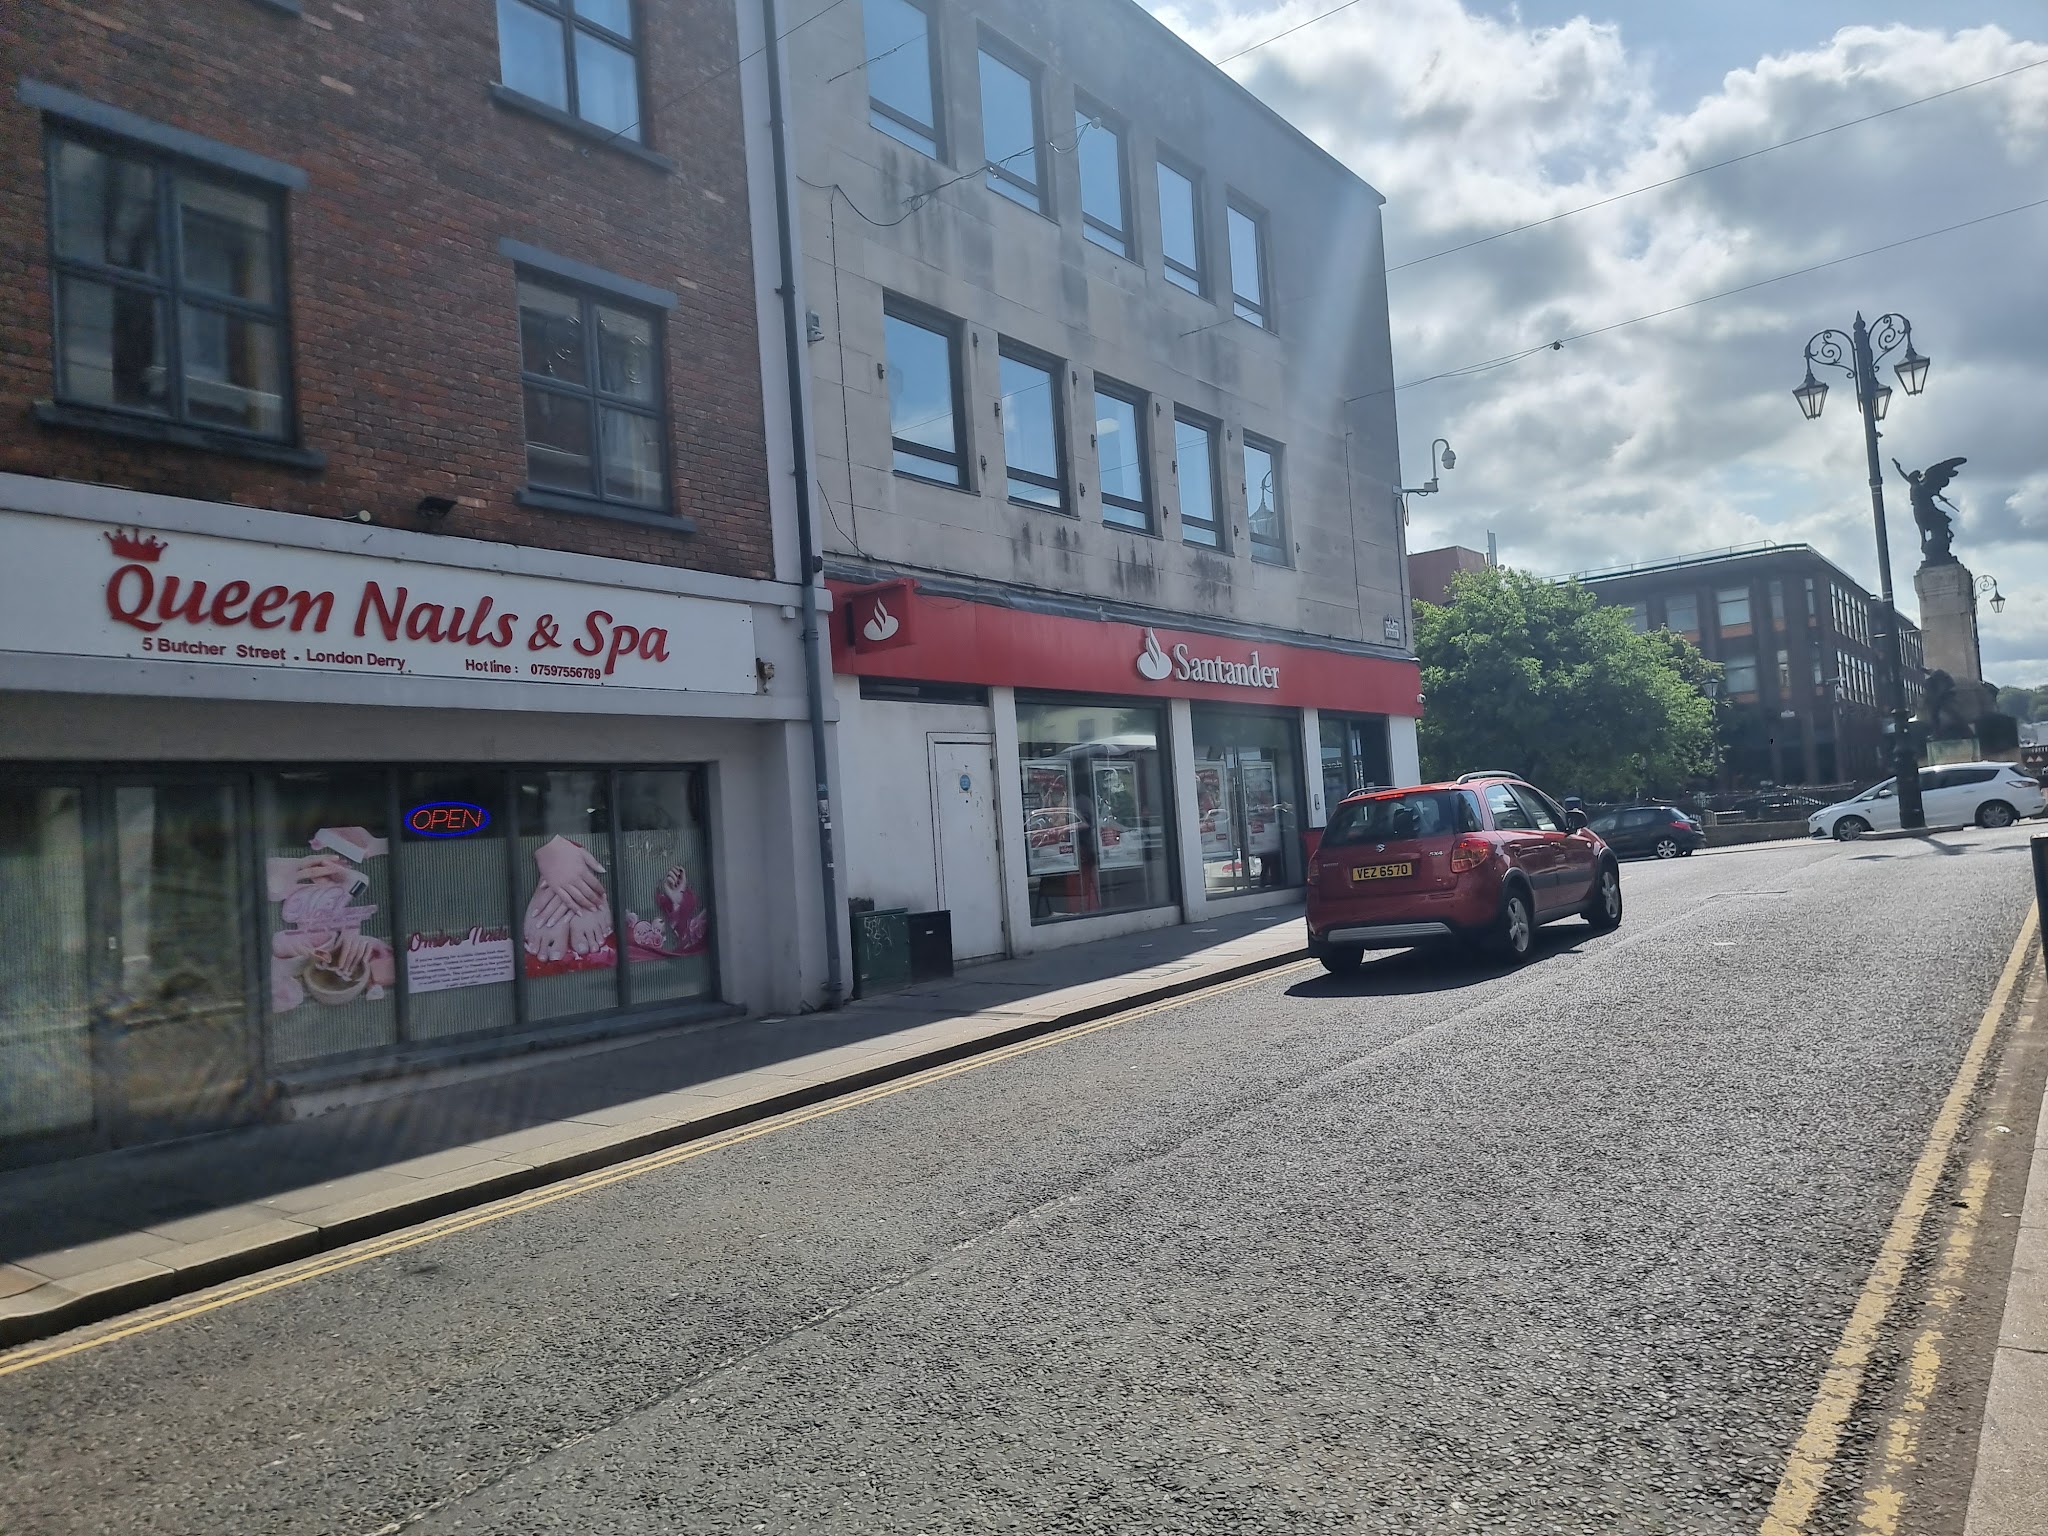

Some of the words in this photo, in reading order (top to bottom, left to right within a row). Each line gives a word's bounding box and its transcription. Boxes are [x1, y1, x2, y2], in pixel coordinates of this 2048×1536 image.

[106, 563, 335, 632] Queen
[353, 580, 519, 648] Nails
[528, 613, 562, 651] &
[573, 609, 670, 675] Spa
[142, 637, 153, 651] 5
[157, 637, 227, 656] Butcher
[236, 643, 287, 660] Street
[306, 648, 363, 665] London
[530, 663, 601, 680] 07597556789
[1173, 643, 1280, 689] Santander
[412, 808, 482, 830] OPEN
[1357, 867, 1378, 879] VEZ
[1380, 864, 1408, 877] 6570
